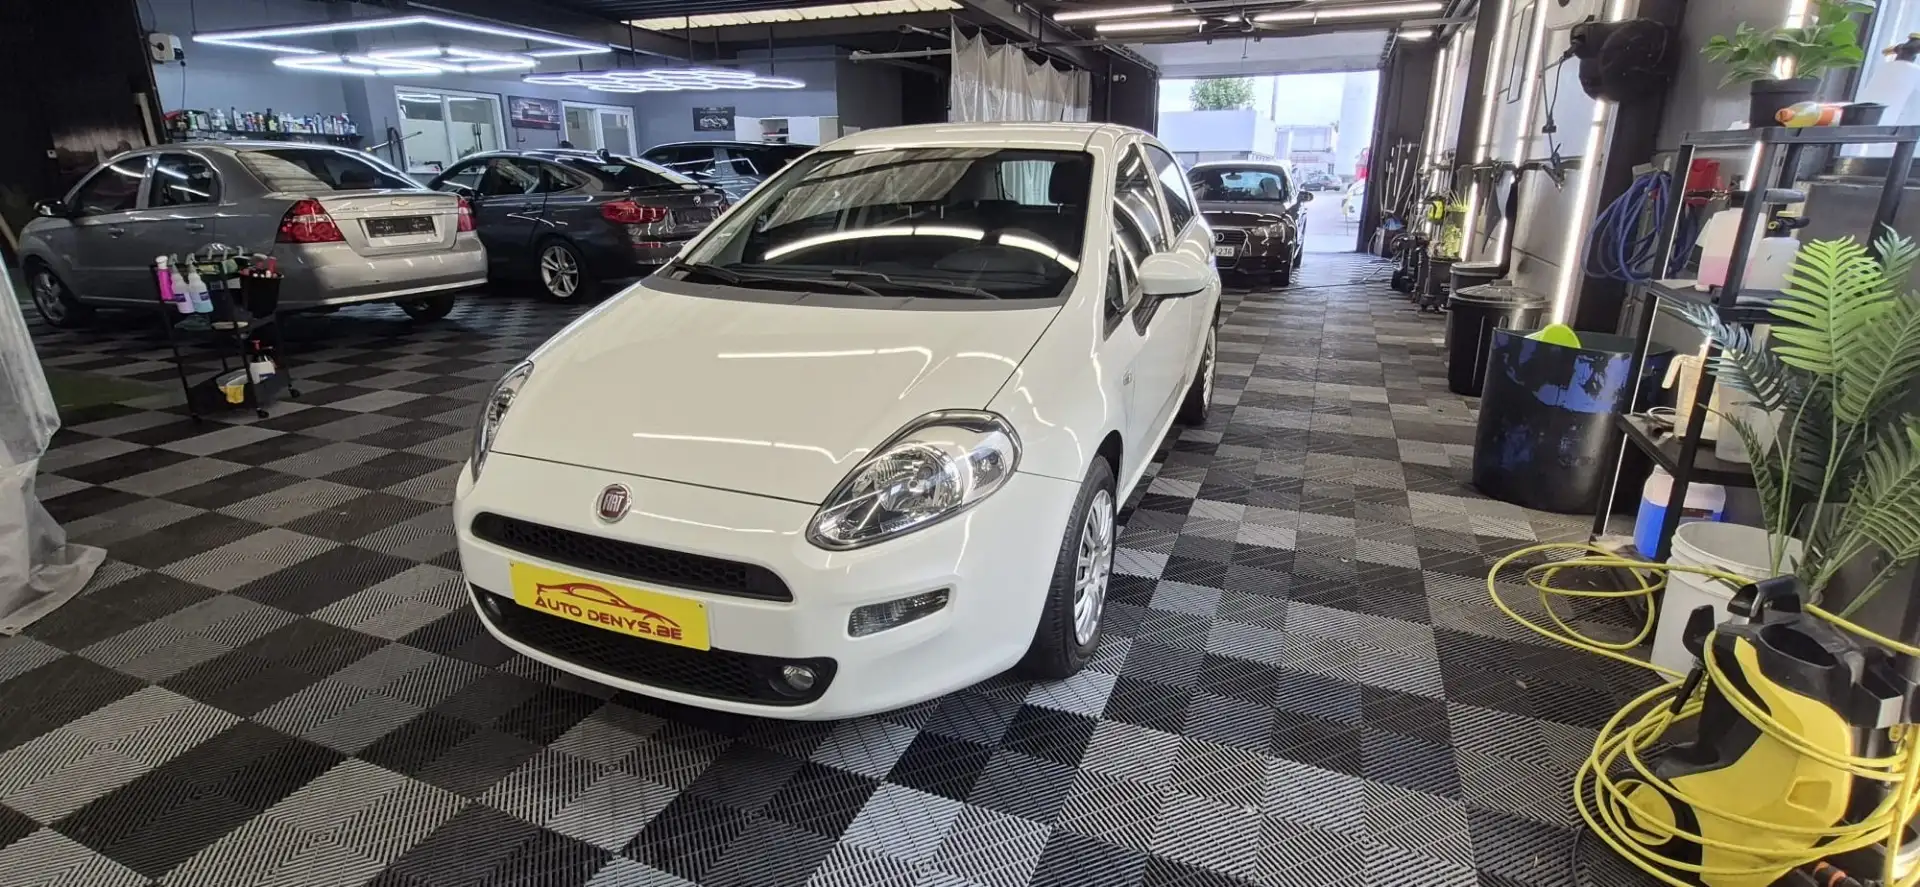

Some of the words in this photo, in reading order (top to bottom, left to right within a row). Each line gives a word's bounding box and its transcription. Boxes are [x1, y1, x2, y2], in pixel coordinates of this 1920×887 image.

[603, 494, 624, 512] FIAT
[535, 596, 582, 617] AUTO
[587, 609, 682, 640] DENYS.BE
